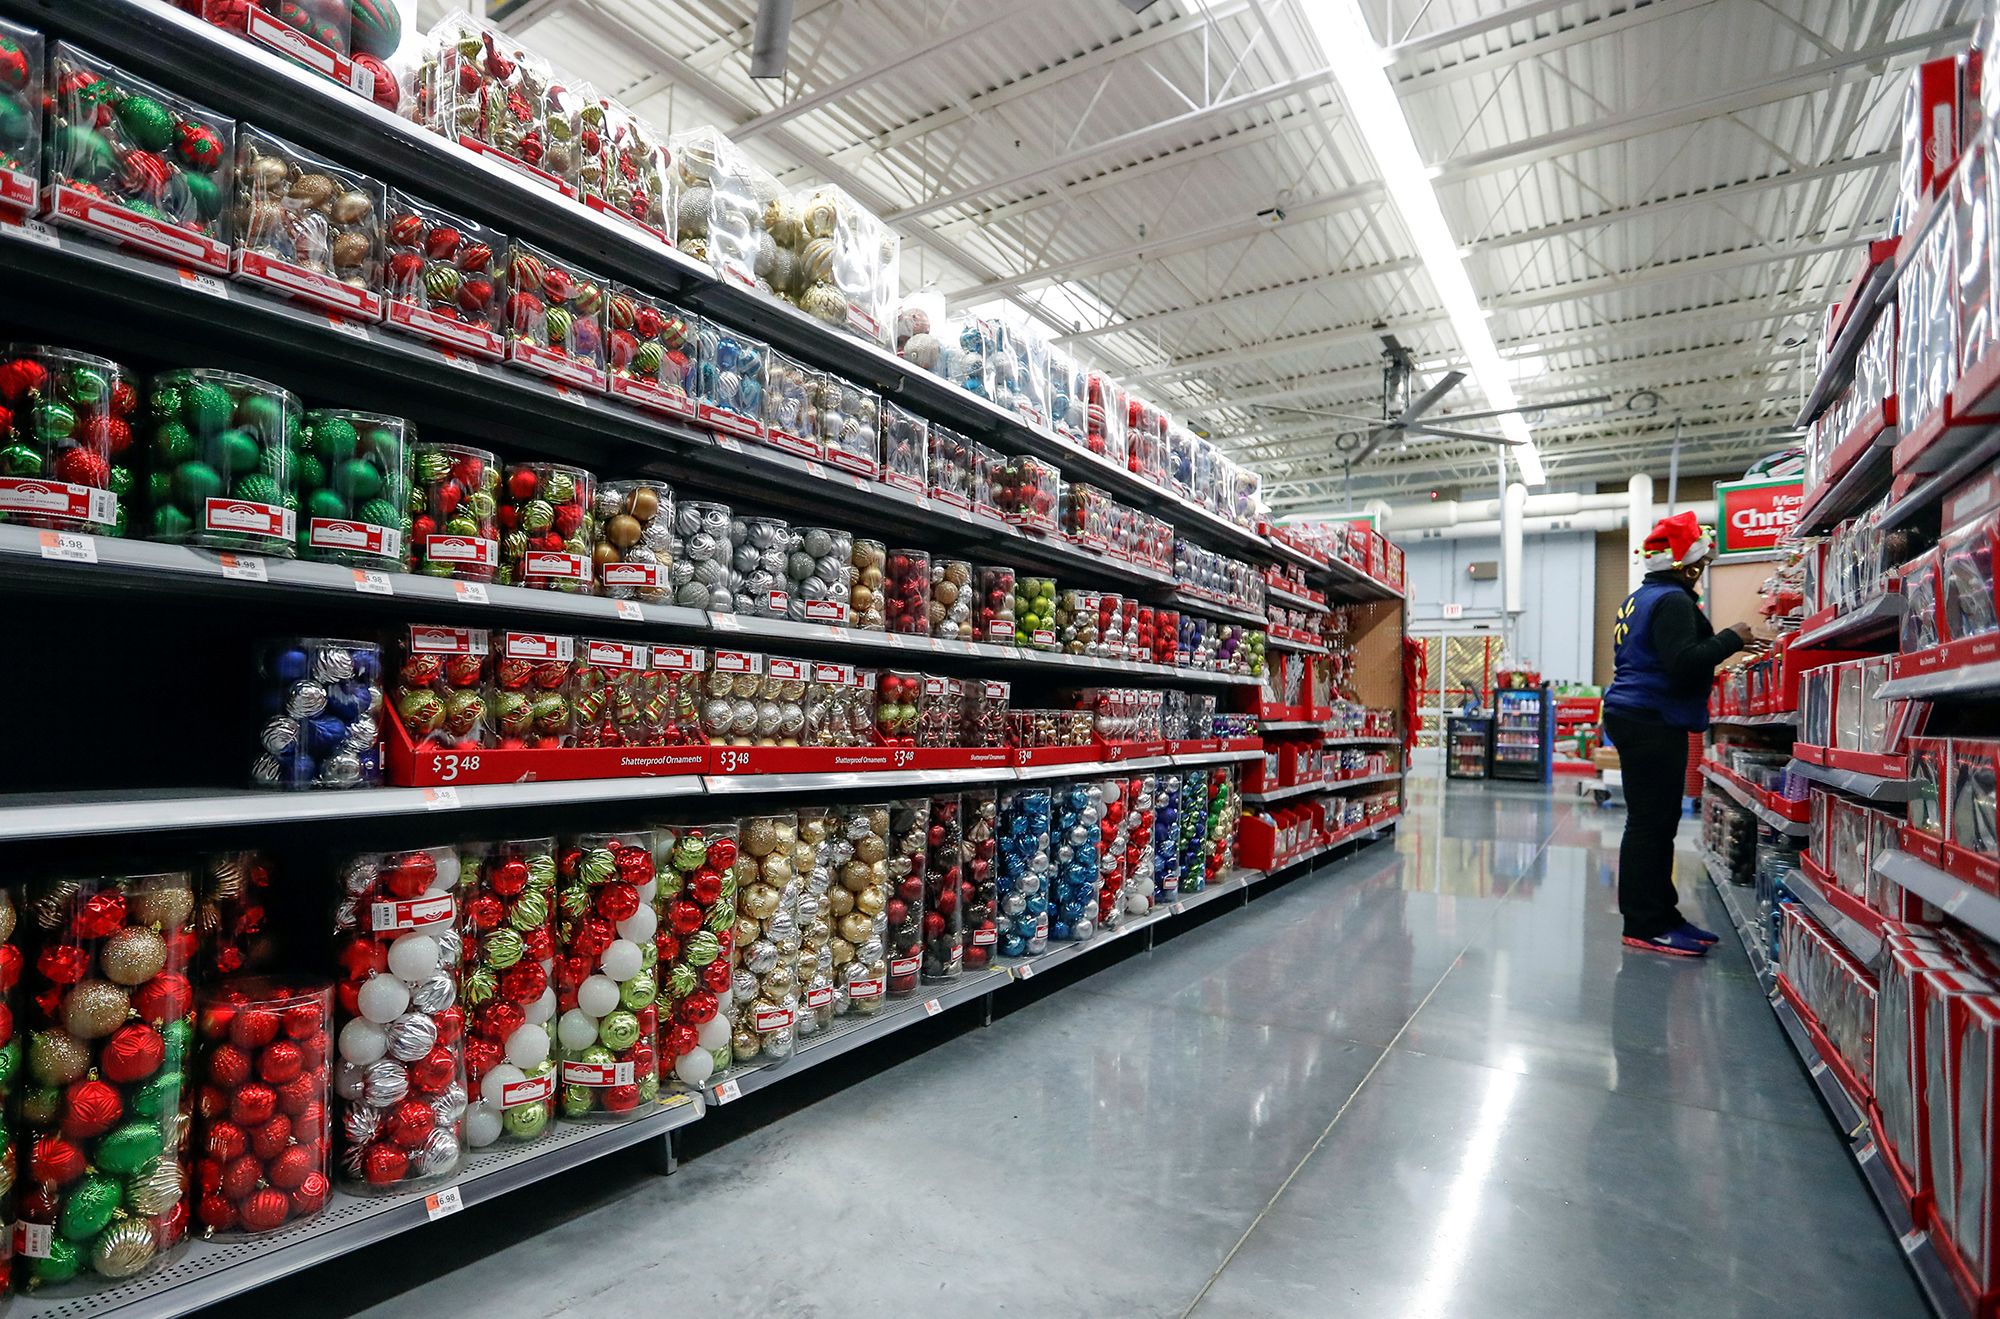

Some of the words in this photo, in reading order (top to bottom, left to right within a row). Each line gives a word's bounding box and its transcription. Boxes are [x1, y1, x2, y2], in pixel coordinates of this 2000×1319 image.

[1446, 606, 1460, 615] EXIT
[621, 755, 666, 767] Shatterproof
[666, 755, 702, 764] Ornaments
[835, 755, 863, 766] Shatterproof
[863, 756, 887, 764] Ornaments
